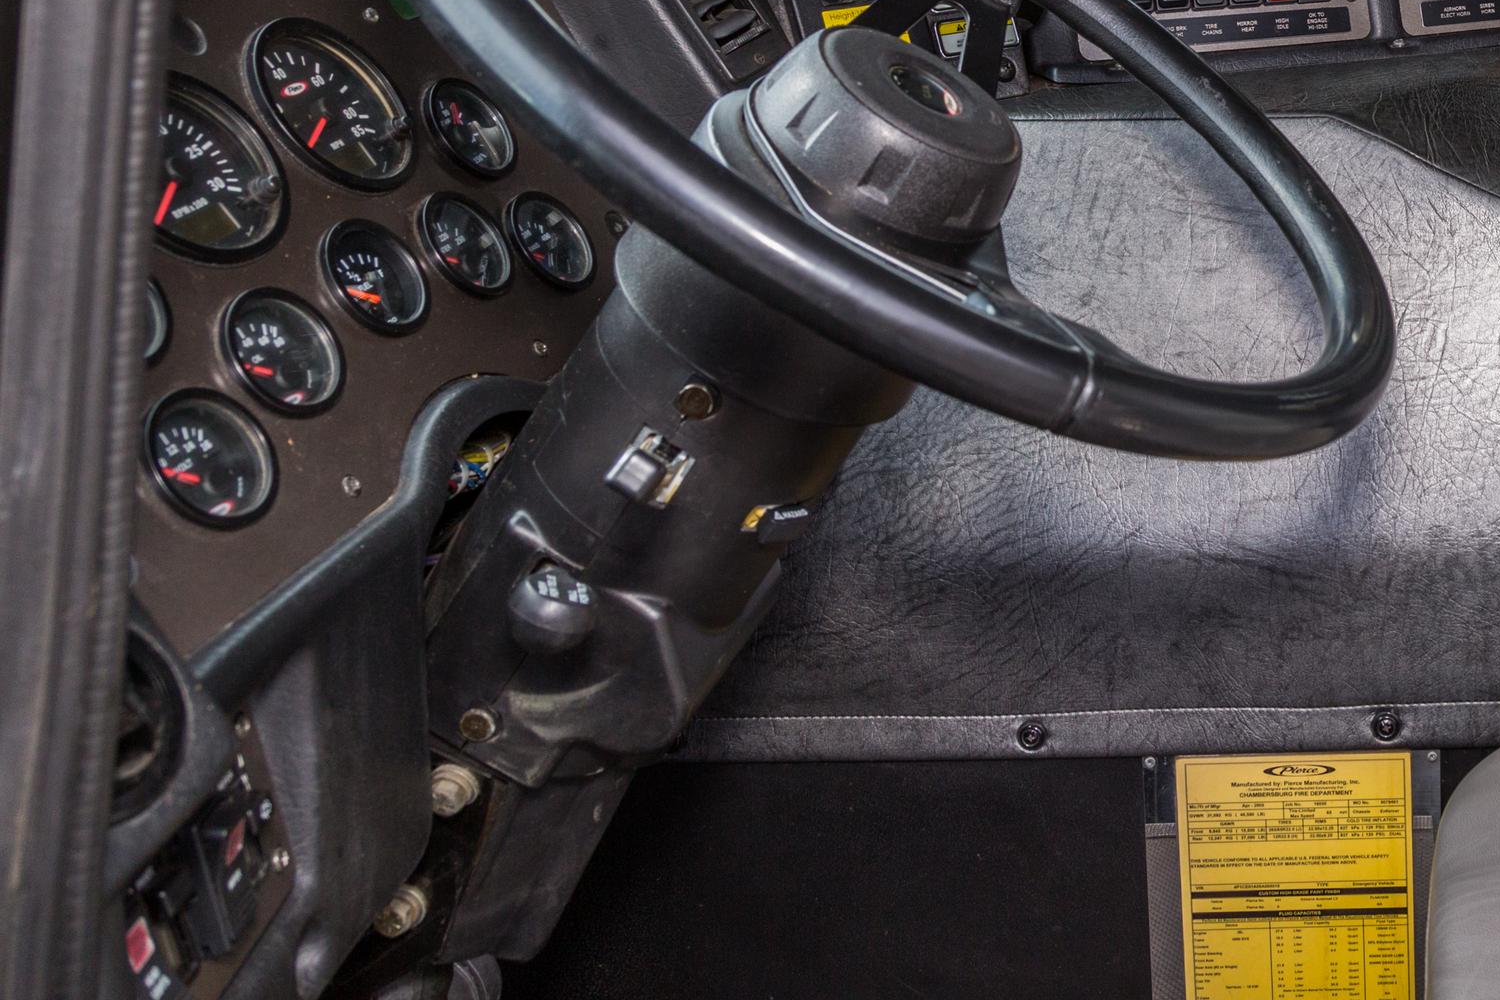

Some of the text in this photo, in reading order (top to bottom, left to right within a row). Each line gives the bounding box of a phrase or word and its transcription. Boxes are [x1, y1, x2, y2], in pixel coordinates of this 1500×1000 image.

[1306, 17, 1328, 25] ENGAGE
[272, 67, 287, 81] 40
[310, 74, 326, 88] 60
[342, 106, 358, 120] 80
[351, 124, 366, 138] 85
[184, 143, 204, 160] 25
[329, 138, 346, 151] MPH
[206, 176, 226, 192] 30
[782, 508, 809, 519] HAZARD
[1279, 765, 1320, 775] Pierce
[1309, 789, 1353, 797] DEPARTMENT
